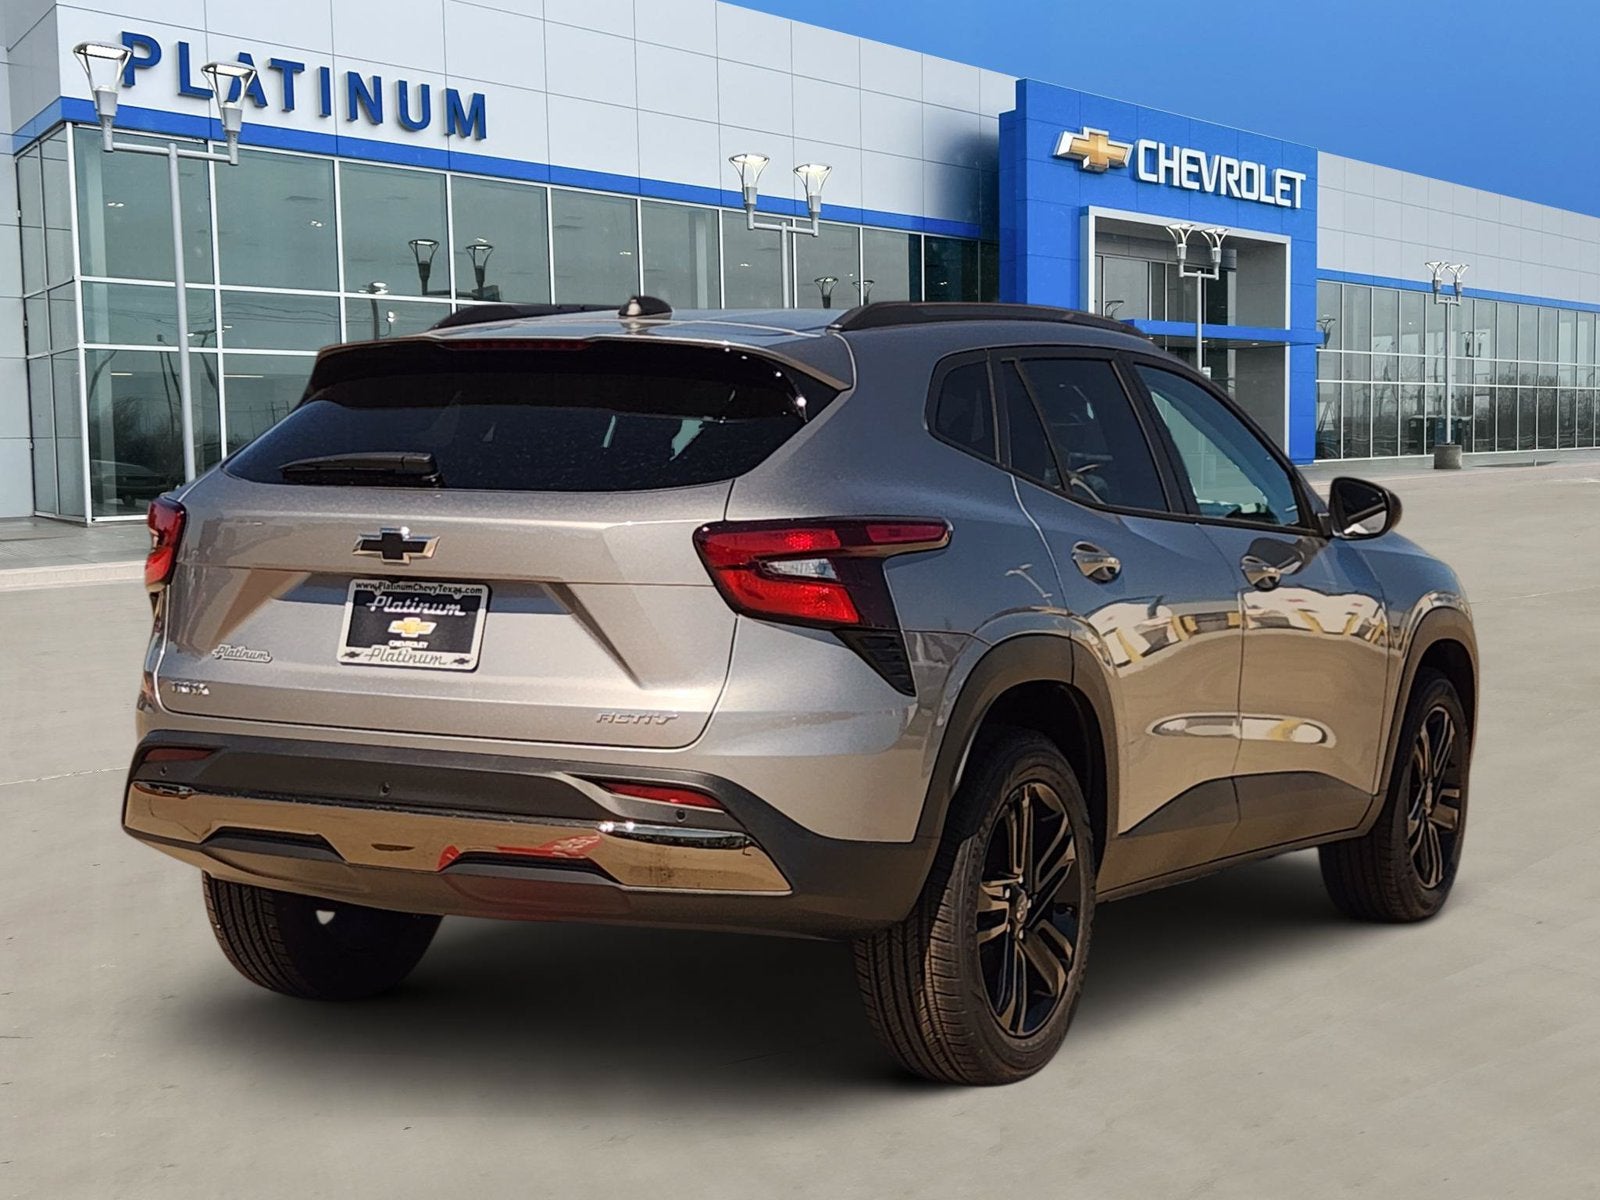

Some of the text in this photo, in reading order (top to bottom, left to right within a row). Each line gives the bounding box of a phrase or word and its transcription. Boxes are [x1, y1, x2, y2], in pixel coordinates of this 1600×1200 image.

[119, 31, 487, 140] PLATINUM
[1136, 138, 1307, 209] CHEVROLET
[366, 596, 466, 616] Platinum
[212, 643, 273, 664] Platinum
[365, 647, 447, 665] Platinum
[596, 711, 679, 725] ACTIV
